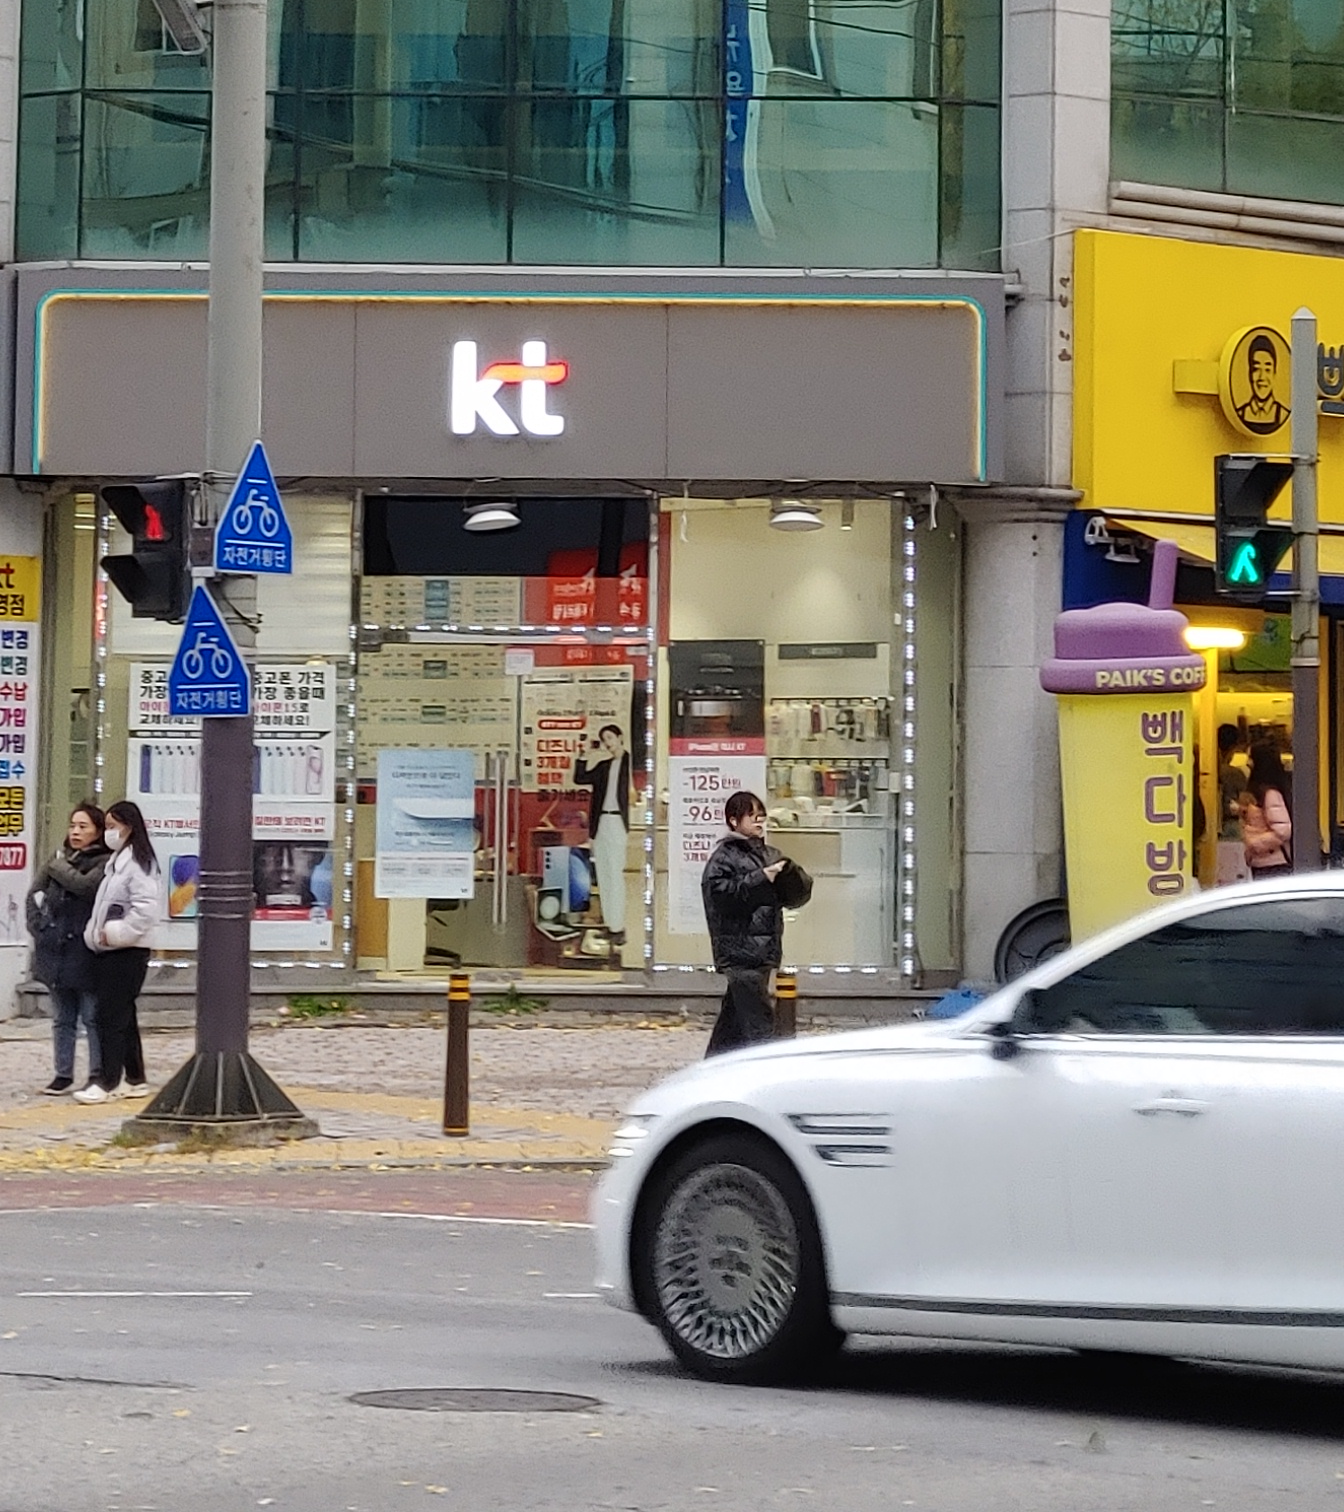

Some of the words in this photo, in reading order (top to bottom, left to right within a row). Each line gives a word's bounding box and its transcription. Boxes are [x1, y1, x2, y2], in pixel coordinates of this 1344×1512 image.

[450, 339, 569, 437] kt
[223, 547, 287, 568] 자전거횡단
[298, 671, 326, 685] 가격
[1095, 668, 1166, 689] PAIK'S
[176, 690, 243, 711] 자전거횡단
[1140, 709, 1185, 897] 빽다방
